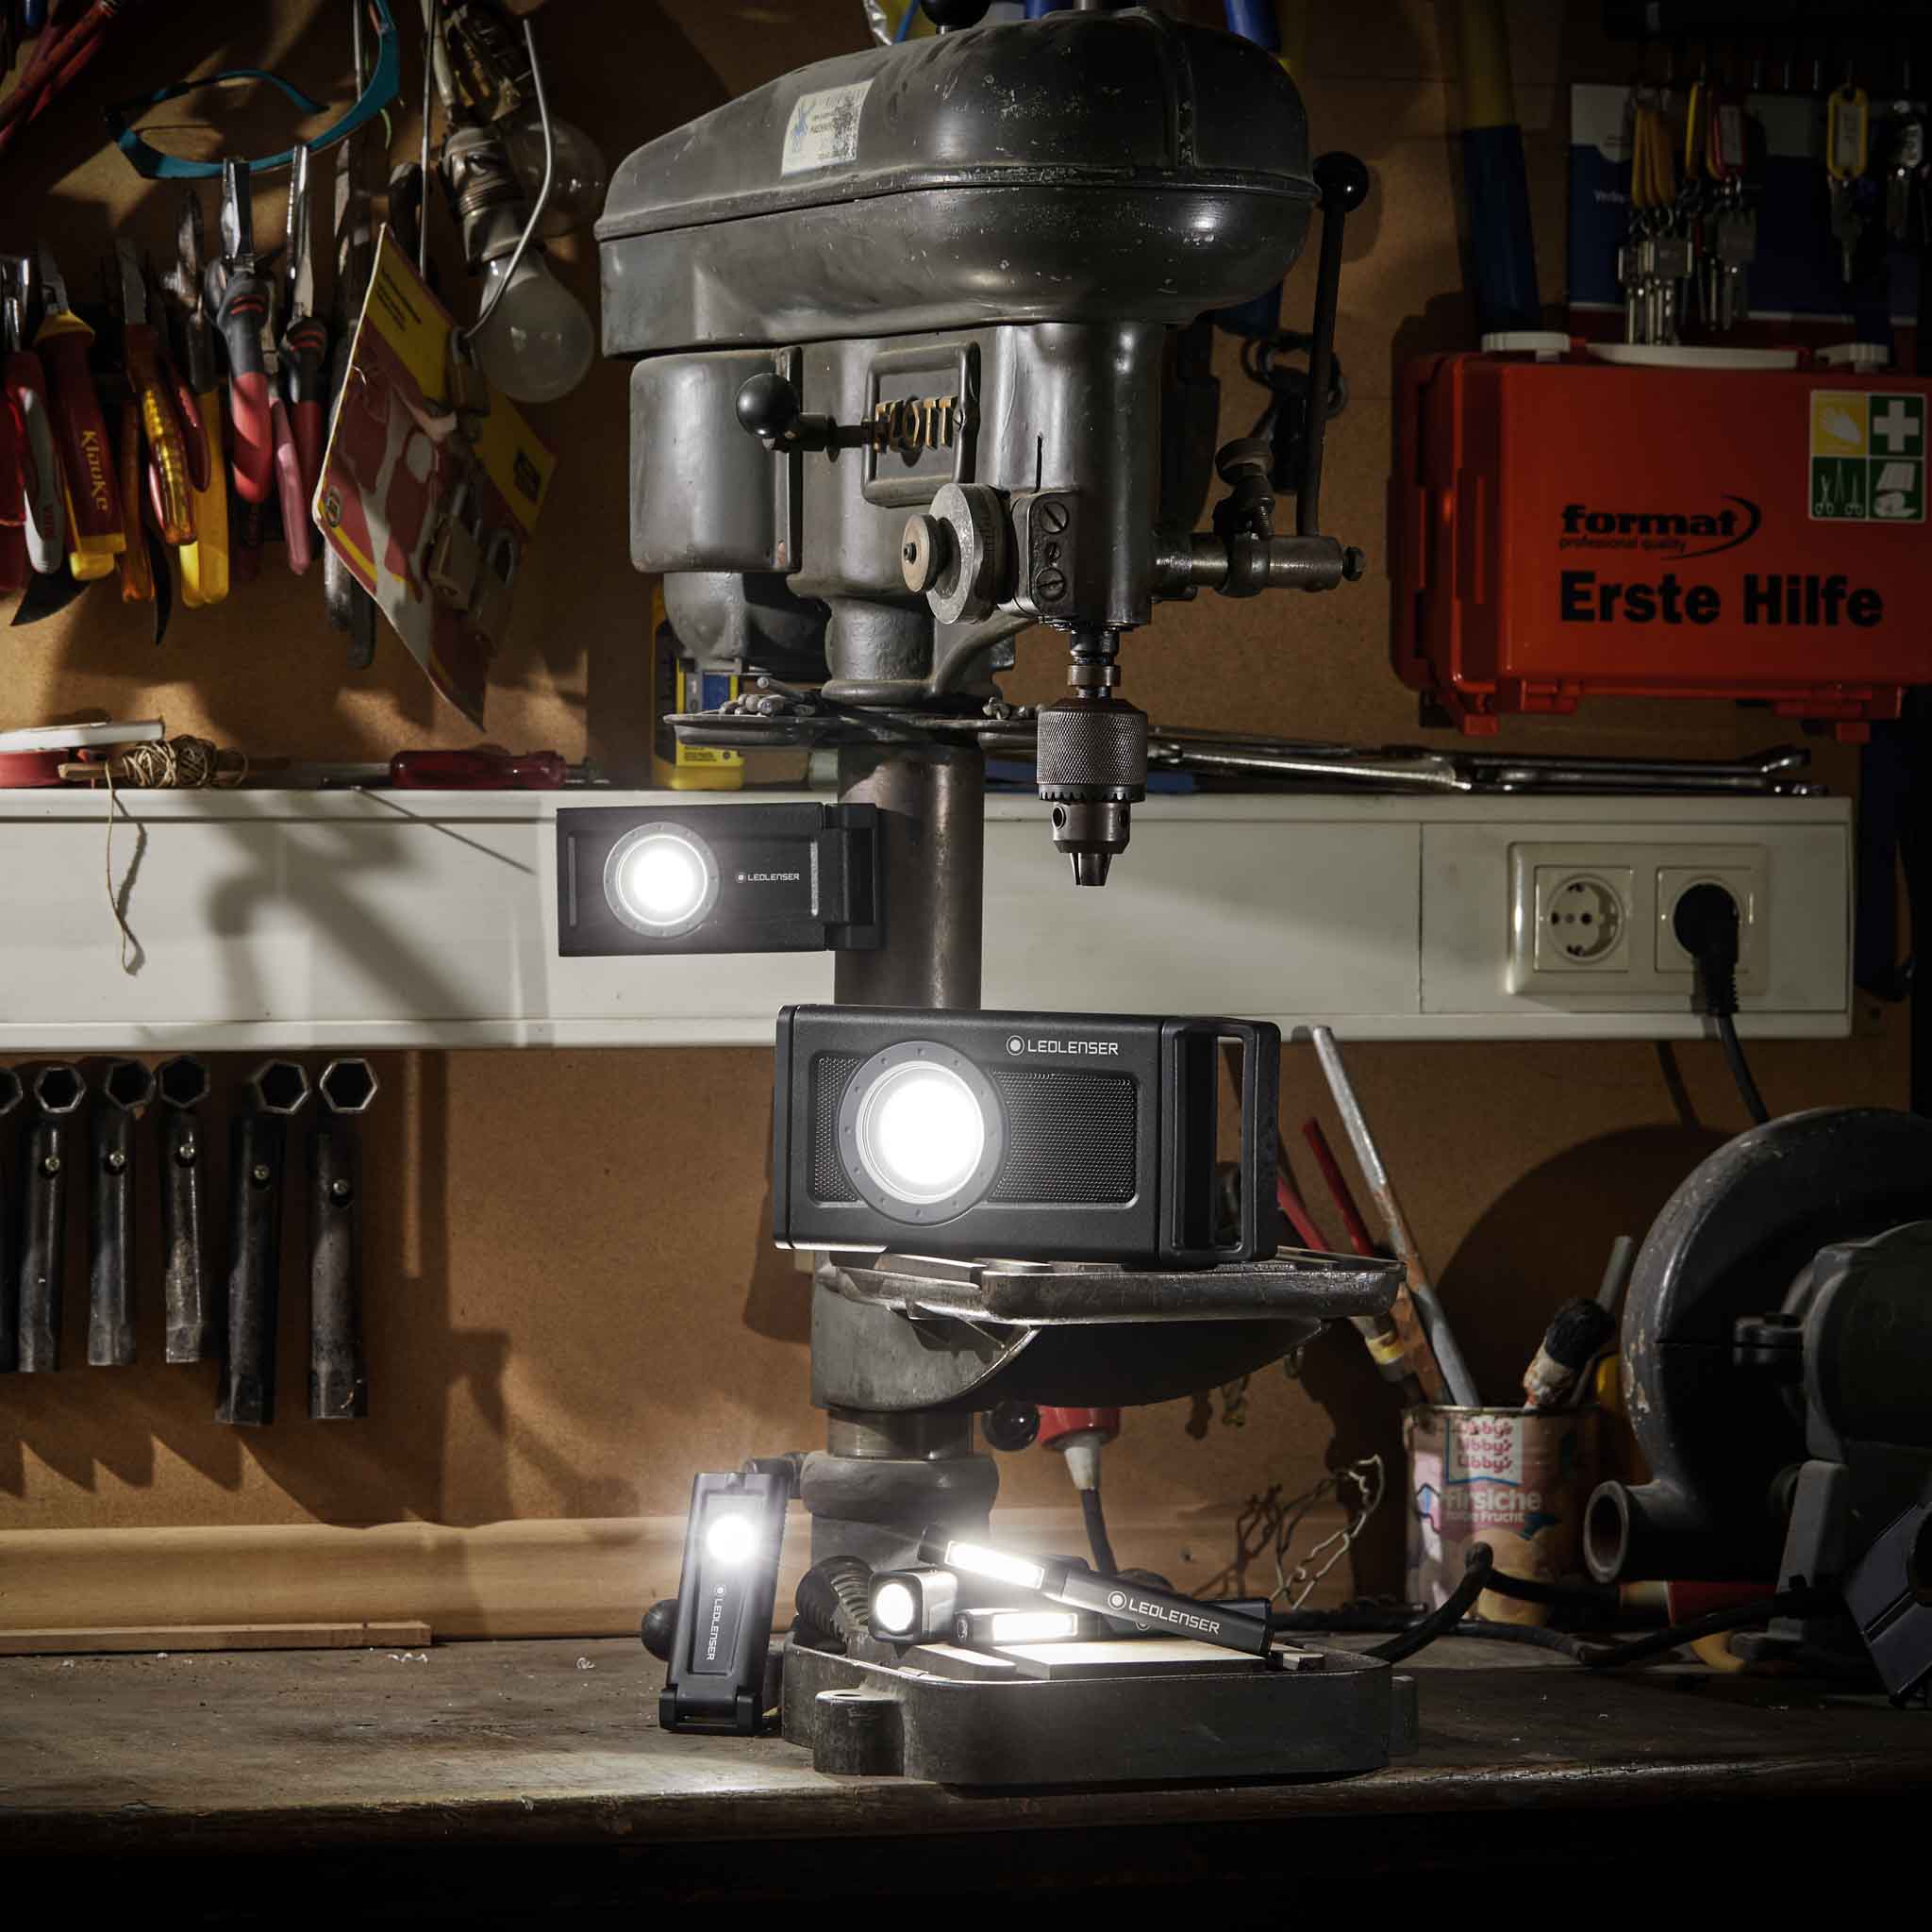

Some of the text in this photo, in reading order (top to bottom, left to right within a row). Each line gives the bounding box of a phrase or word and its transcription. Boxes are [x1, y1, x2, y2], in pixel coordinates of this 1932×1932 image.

[1561, 504, 1739, 536] format
[1561, 571, 1884, 627] Erste Hilfe
[747, 873, 800, 882] LEDLENSER
[1027, 1039, 1119, 1056] LEDLENSER
[707, 1598, 724, 1661] LEDLENSER
[1128, 1597, 1221, 1635] LEDLENSER
